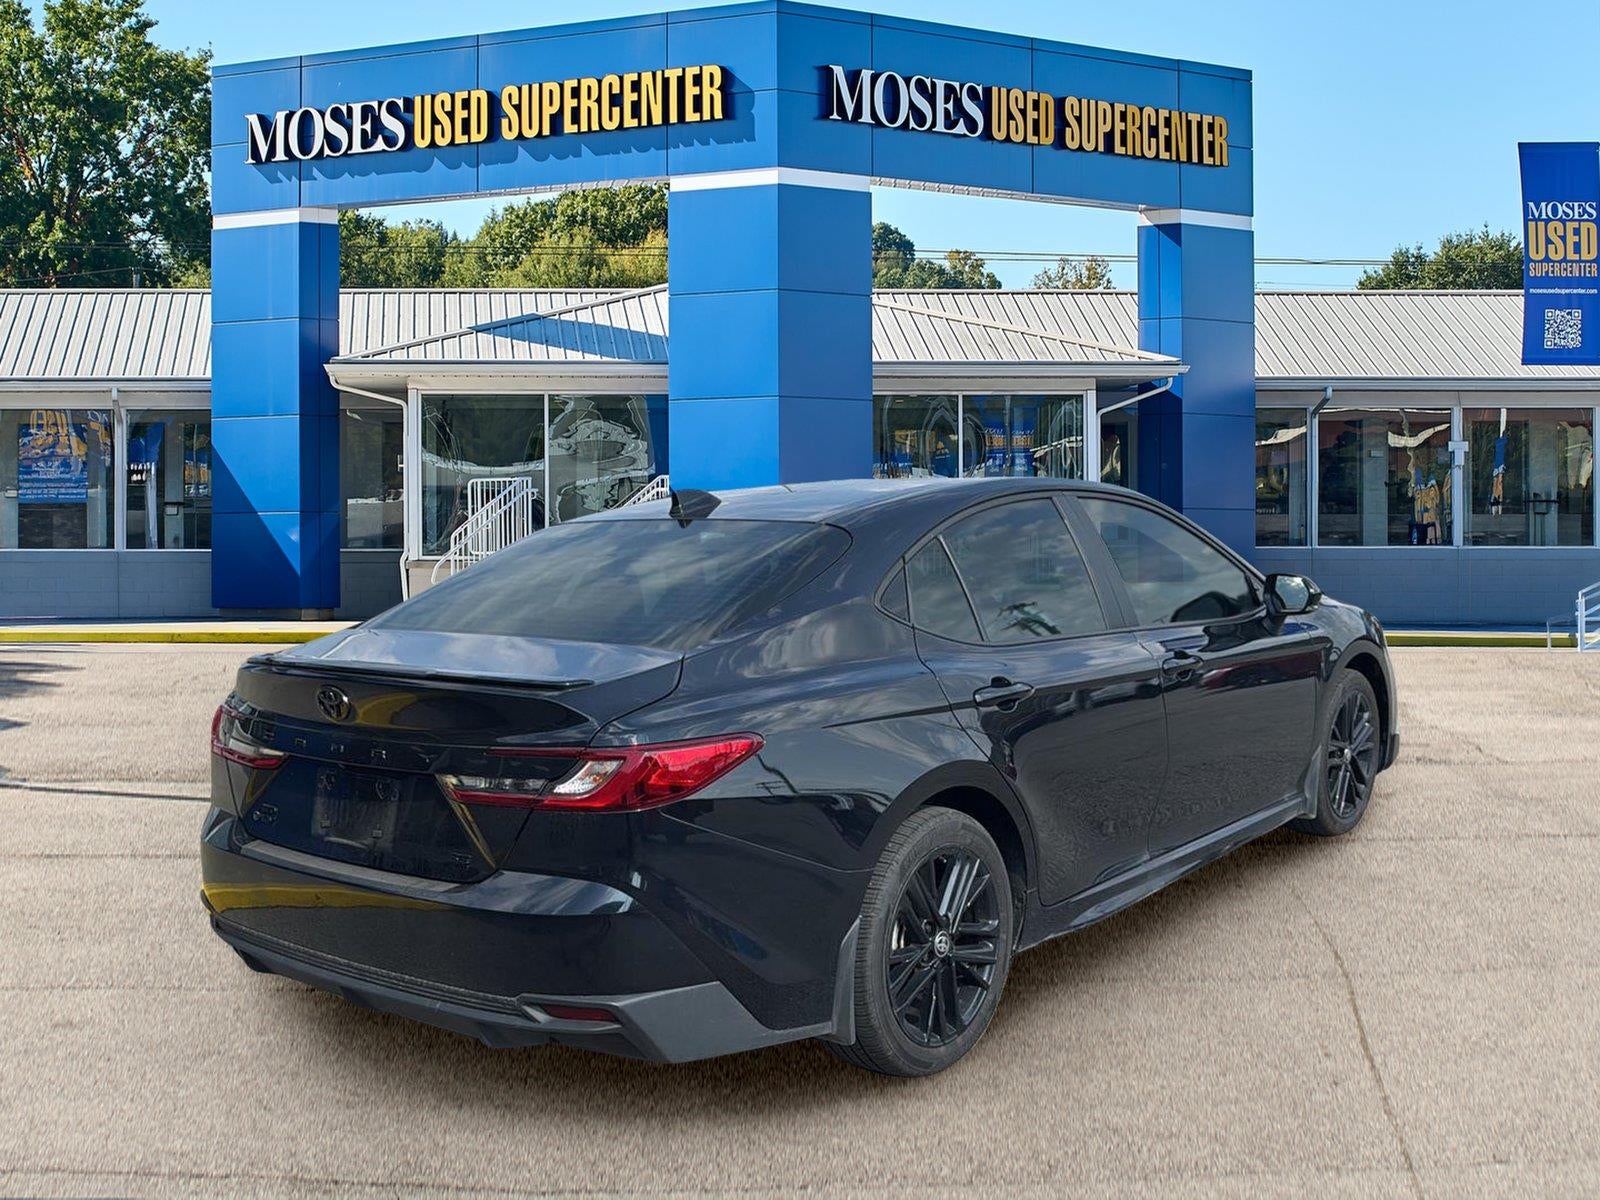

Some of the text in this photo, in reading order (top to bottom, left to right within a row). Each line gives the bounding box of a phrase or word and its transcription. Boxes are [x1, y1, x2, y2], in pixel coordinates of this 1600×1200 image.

[244, 64, 724, 164] MOSES USED SUPERCENTER
[828, 64, 1230, 167] MOSES USED SUPERCENTER
[1528, 201, 1597, 219] MOSES
[1528, 221, 1598, 260] USED
[1529, 263, 1598, 277] SUPERCENTER
[1529, 287, 1598, 295] mosesusedsupercenter.com
